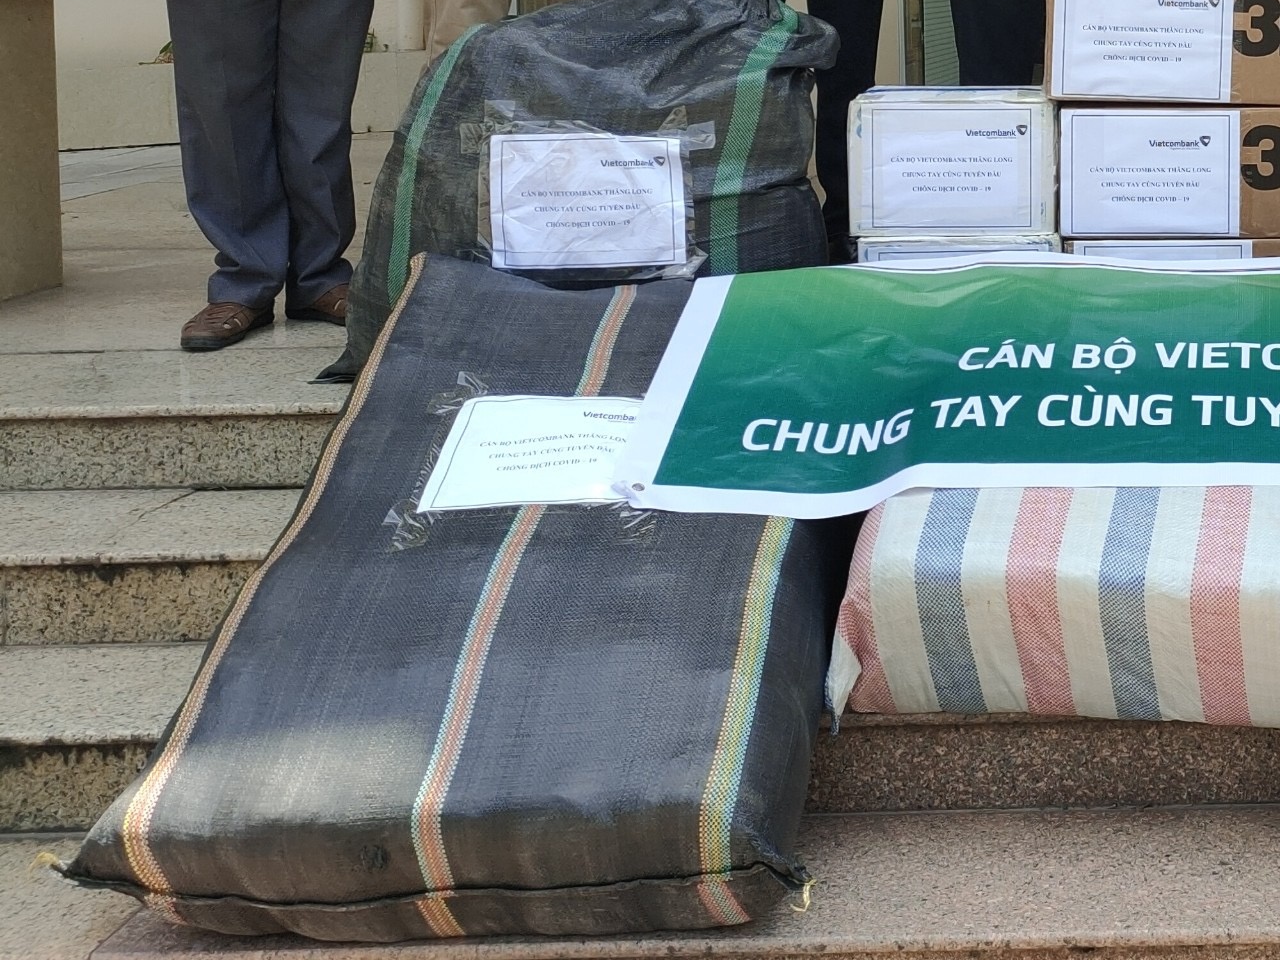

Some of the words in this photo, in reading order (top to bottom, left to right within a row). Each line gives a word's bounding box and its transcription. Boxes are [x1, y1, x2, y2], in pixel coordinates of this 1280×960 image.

[1158, 0, 1208, 8] Vietcombank
[1109, 25, 1159, 33] VIETCOMBANK
[965, 129, 1016, 137] Vietcombank
[601, 159, 654, 167] Vietcombank
[549, 189, 602, 197] VIETCOMBANK
[959, 338, 1055, 371] CÁN
[1073, 337, 1136, 375] BỘ
[583, 411, 636, 422] Vietcomba
[743, 409, 914, 455] CHUNG
[931, 395, 1022, 428] TAY
[1038, 385, 1173, 427] CÙNG
[609, 436, 627, 444] LON
